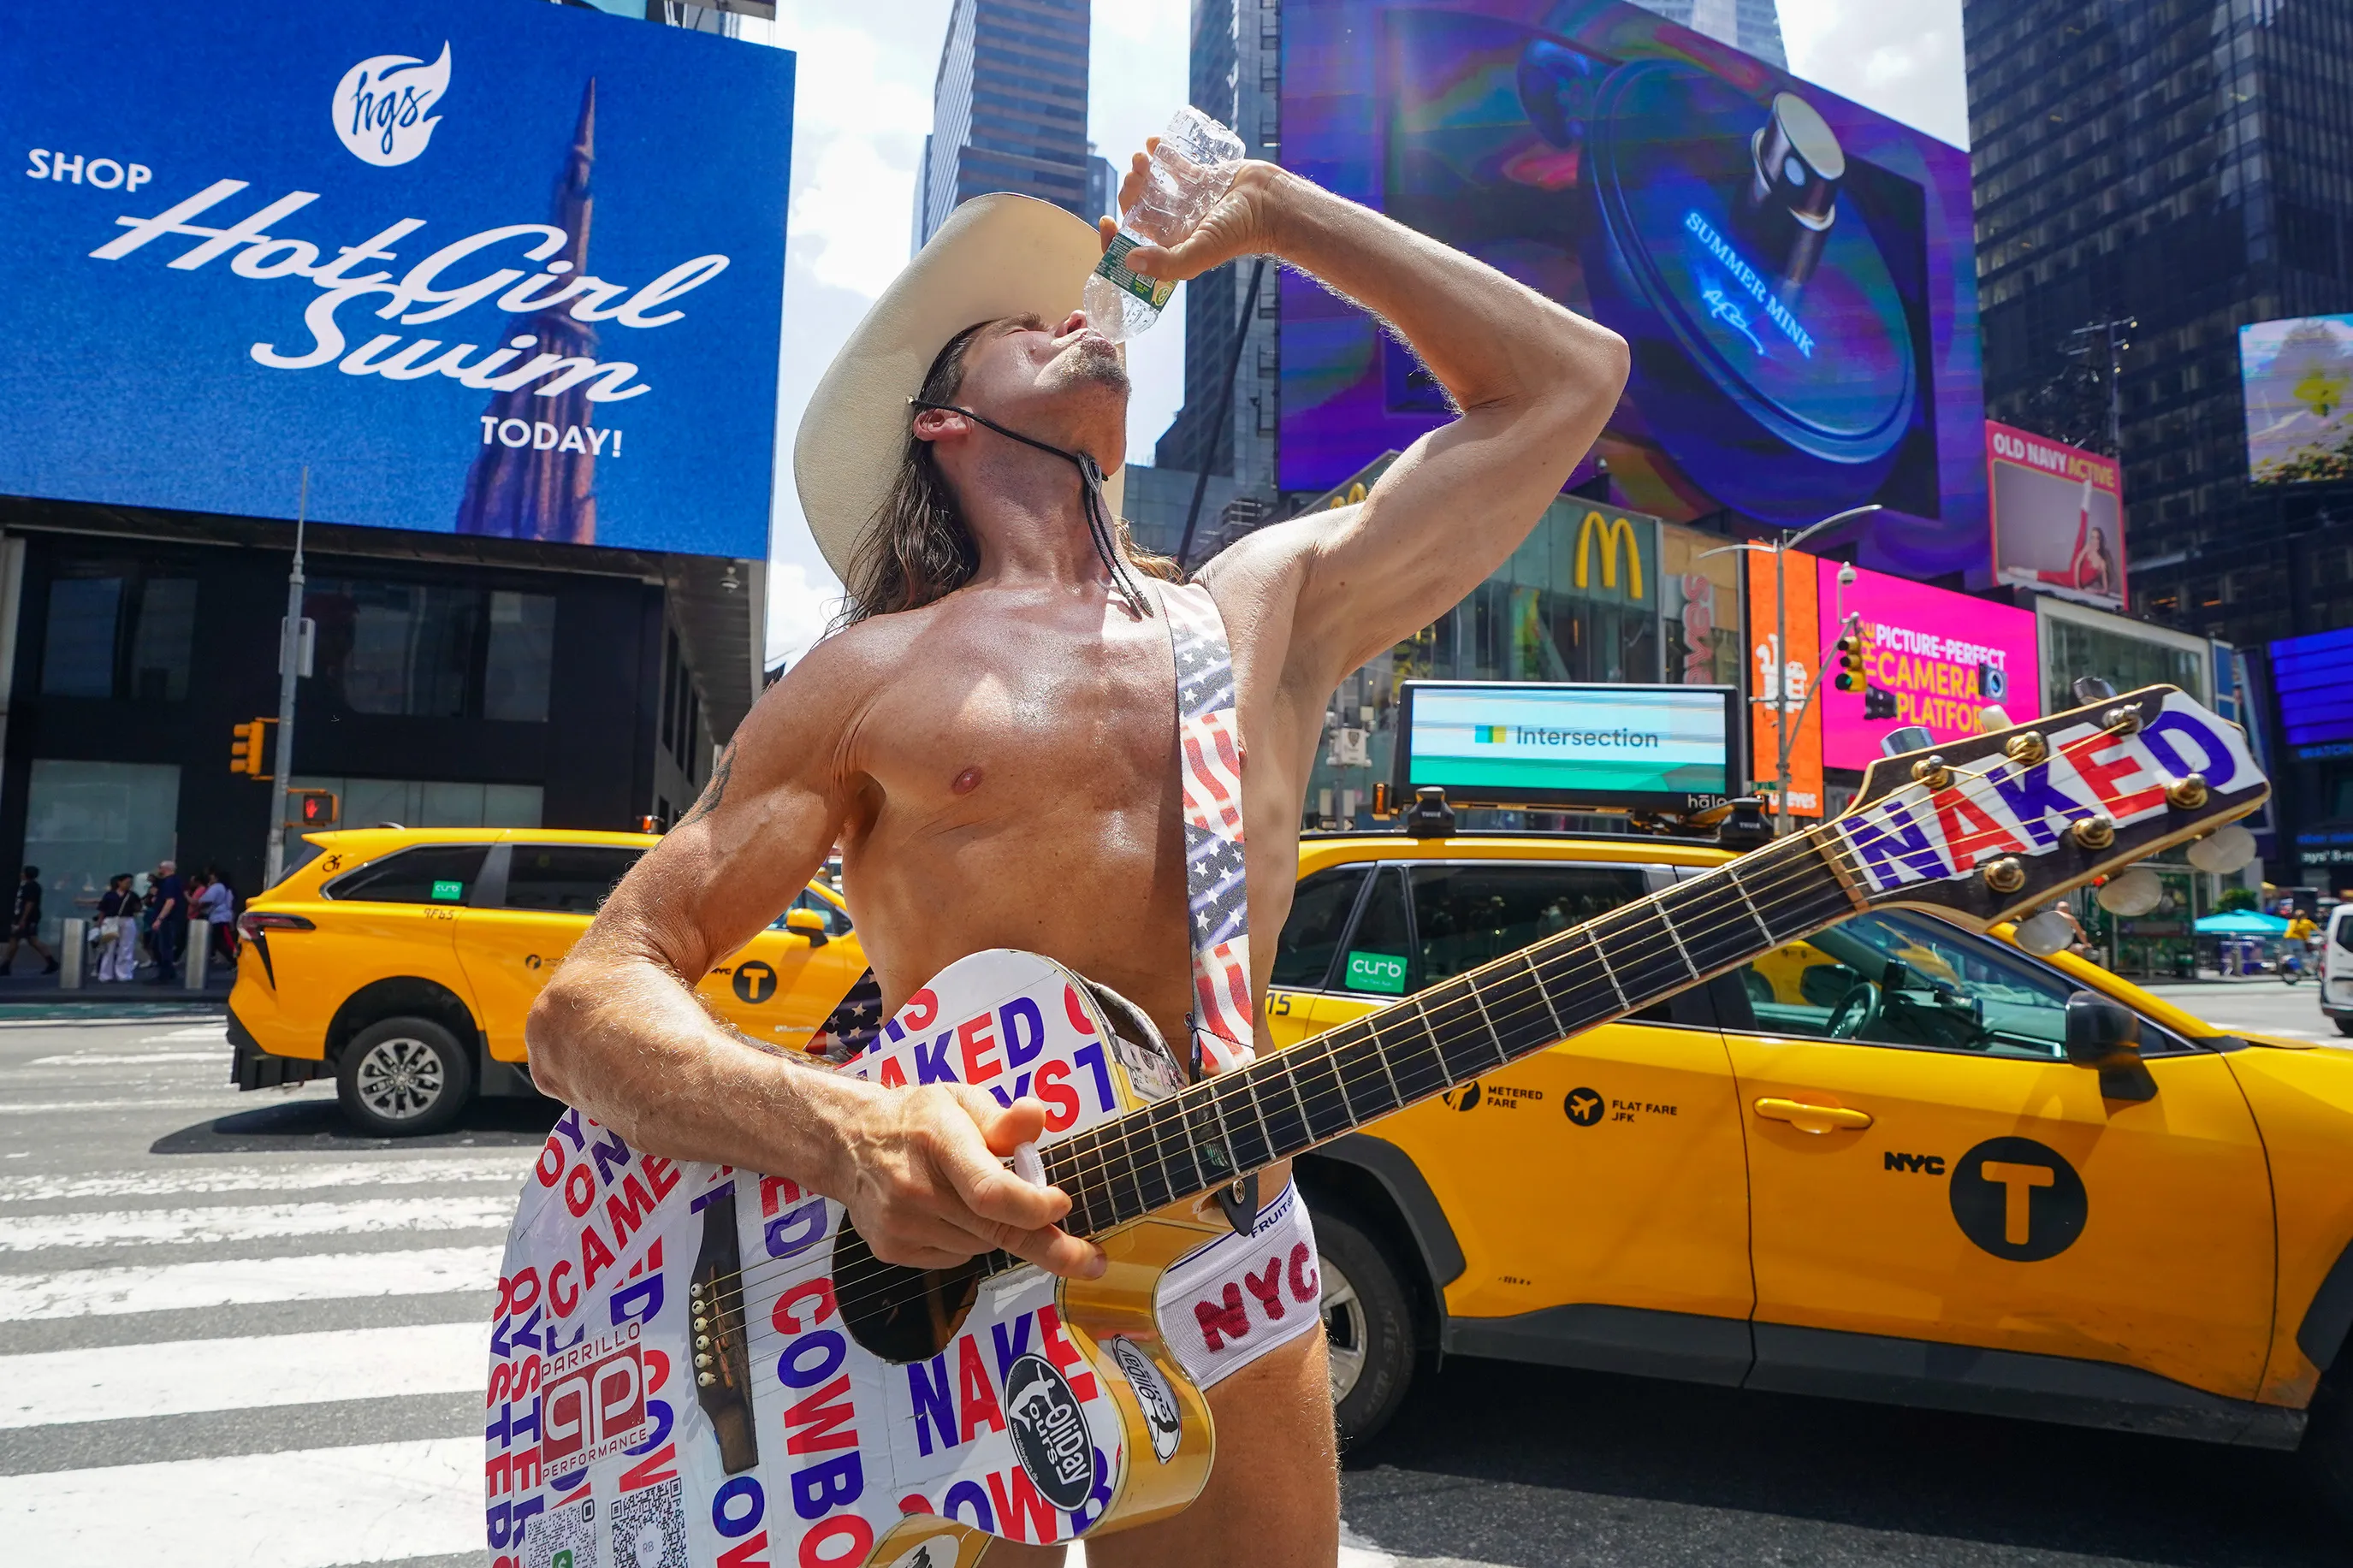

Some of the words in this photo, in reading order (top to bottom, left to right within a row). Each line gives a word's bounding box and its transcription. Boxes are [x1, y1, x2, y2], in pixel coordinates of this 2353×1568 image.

[352, 70, 431, 155] hgs
[26, 147, 152, 192] SHOP
[88, 178, 427, 291] Hot
[399, 223, 731, 328] Girl
[1685, 211, 1767, 303] SUMMER
[1765, 293, 1816, 359] MINK
[250, 286, 652, 402] Swim
[480, 415, 622, 459] TODAY!
[1993, 433, 2026, 459] OLD
[2027, 442, 2068, 472] NAVY
[2067, 456, 2115, 488] ACTIVE
[1876, 624, 2006, 673] PICTURE-PERFECT
[1877, 650, 1983, 701] CAMERA
[1896, 691, 1988, 734] PLATFOR
[1516, 725, 1659, 748] Intersection
[1842, 709, 2237, 889] NAKED
[1352, 959, 1402, 978] curb
[1266, 992, 1292, 1015] 15
[1487, 1097, 1517, 1109] FARE
[1488, 1086, 1544, 1101] METERED
[1612, 1099, 1642, 1112] FLAT
[1645, 1104, 1678, 1115] FARE
[1611, 1112, 1634, 1122] JFK
[1884, 1151, 1946, 1175] NYC
[1250, 1202, 1288, 1238] FRUIT
[1194, 1240, 1319, 1353] NYC
[541, 1322, 641, 1381] PARRILLO
[542, 1428, 648, 1482] PERFORMANCE
